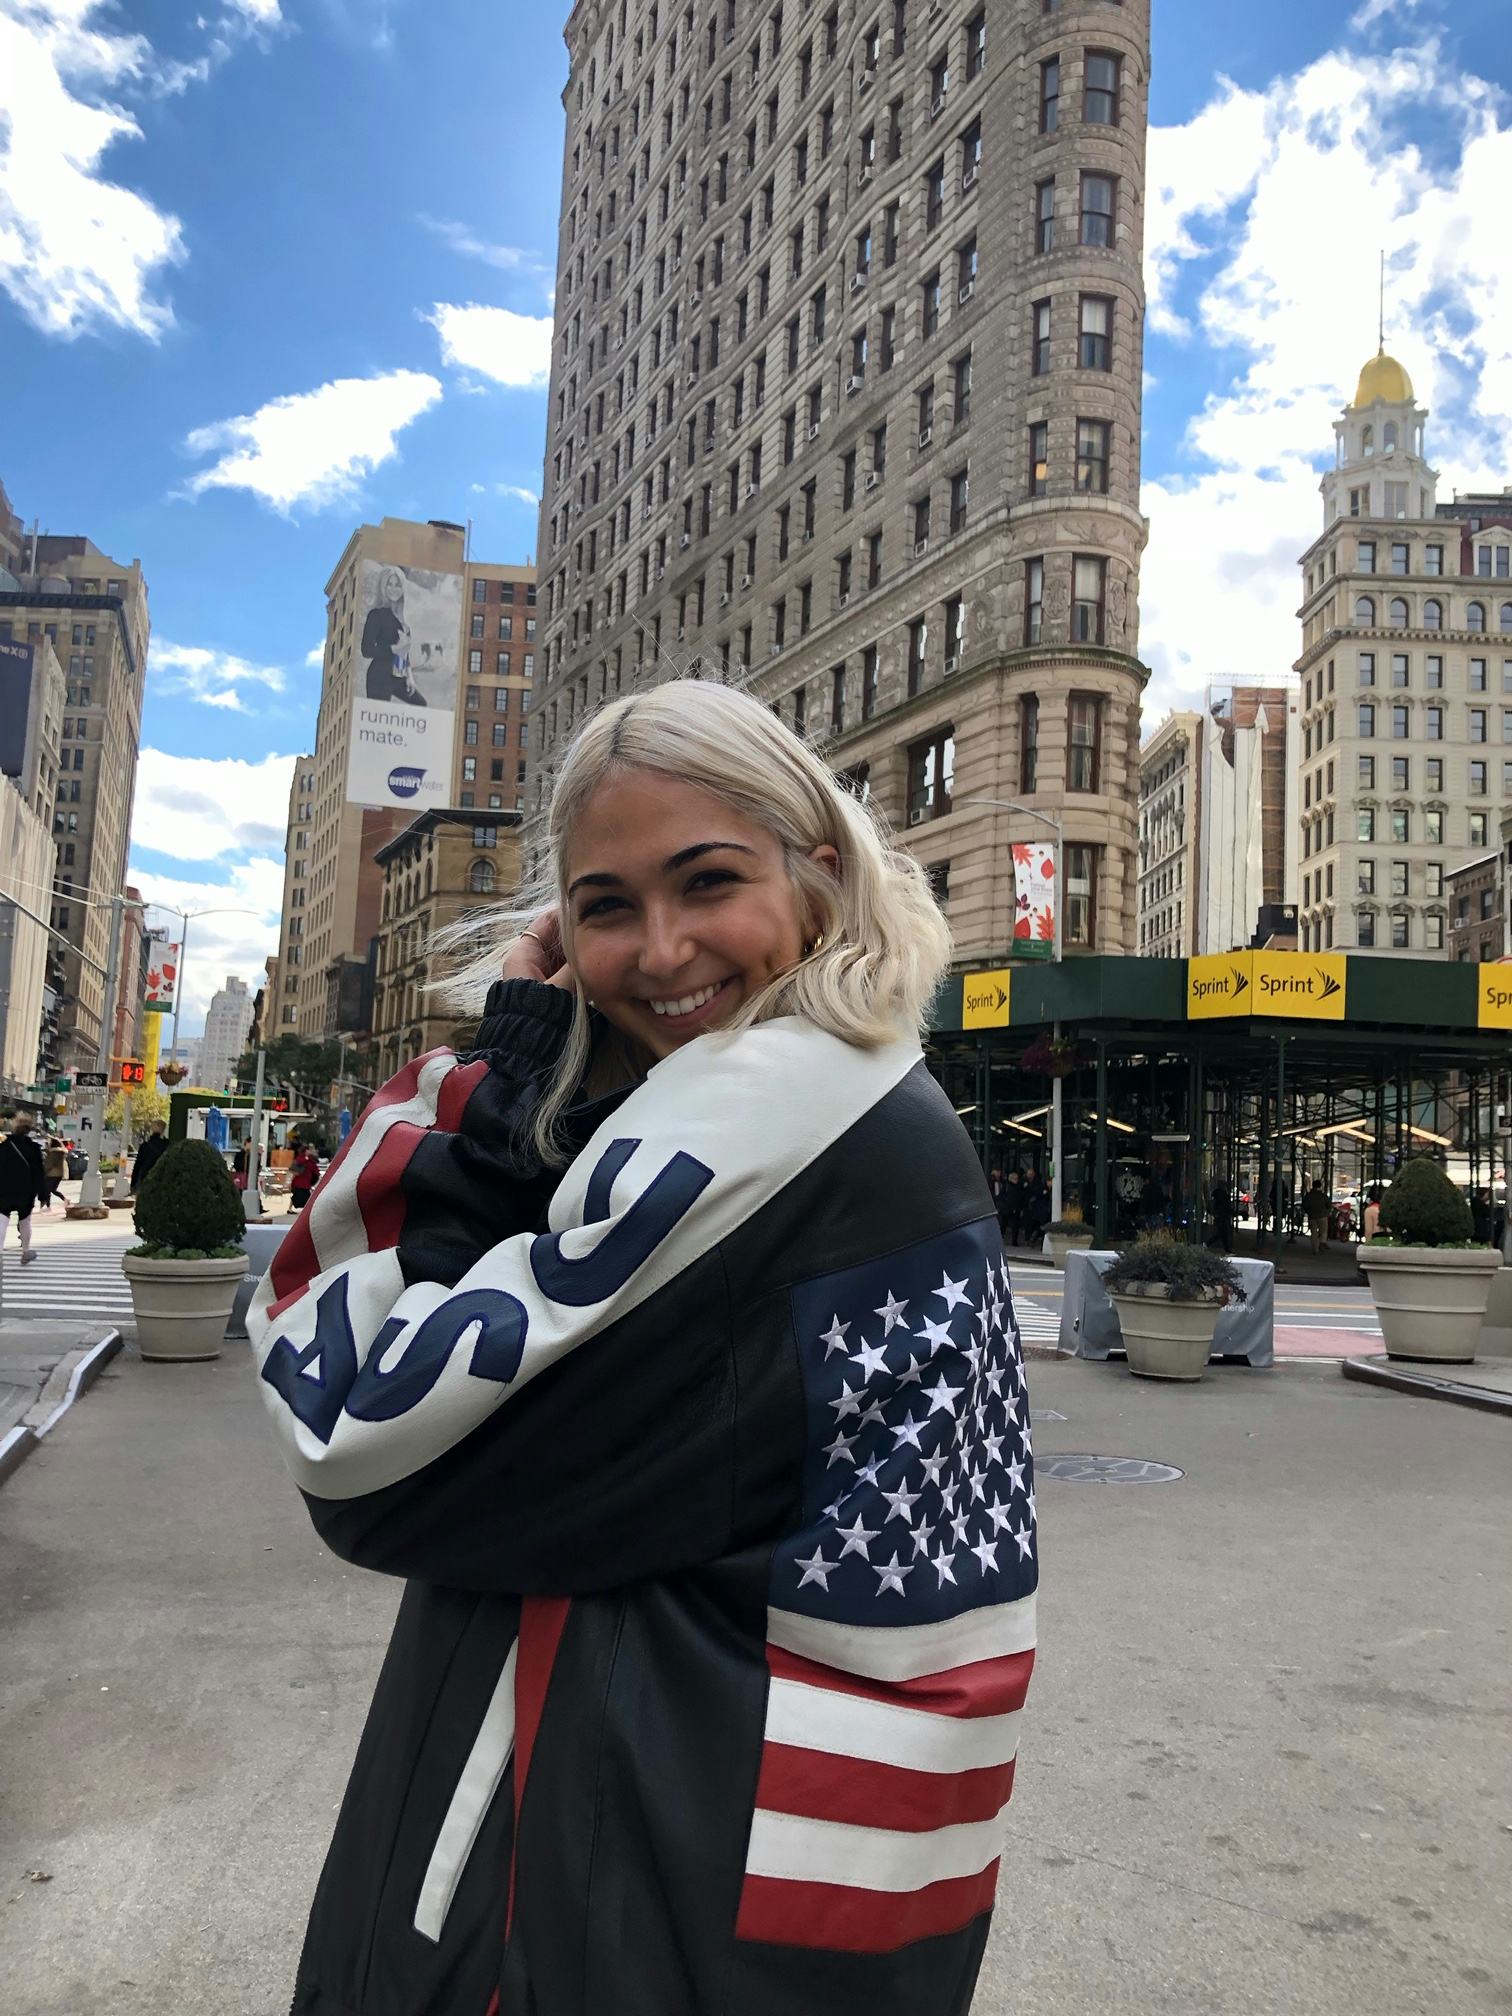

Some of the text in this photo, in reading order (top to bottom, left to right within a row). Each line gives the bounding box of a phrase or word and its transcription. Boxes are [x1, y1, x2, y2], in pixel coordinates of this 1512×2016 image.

[360, 710, 427, 734] running
[359, 729, 407, 747] mate.
[1192, 977, 1229, 1000] Sprint
[1260, 974, 1314, 997] Sprint
[966, 993, 993, 1012] Sprint
[262, 1138, 716, 1445] USA
